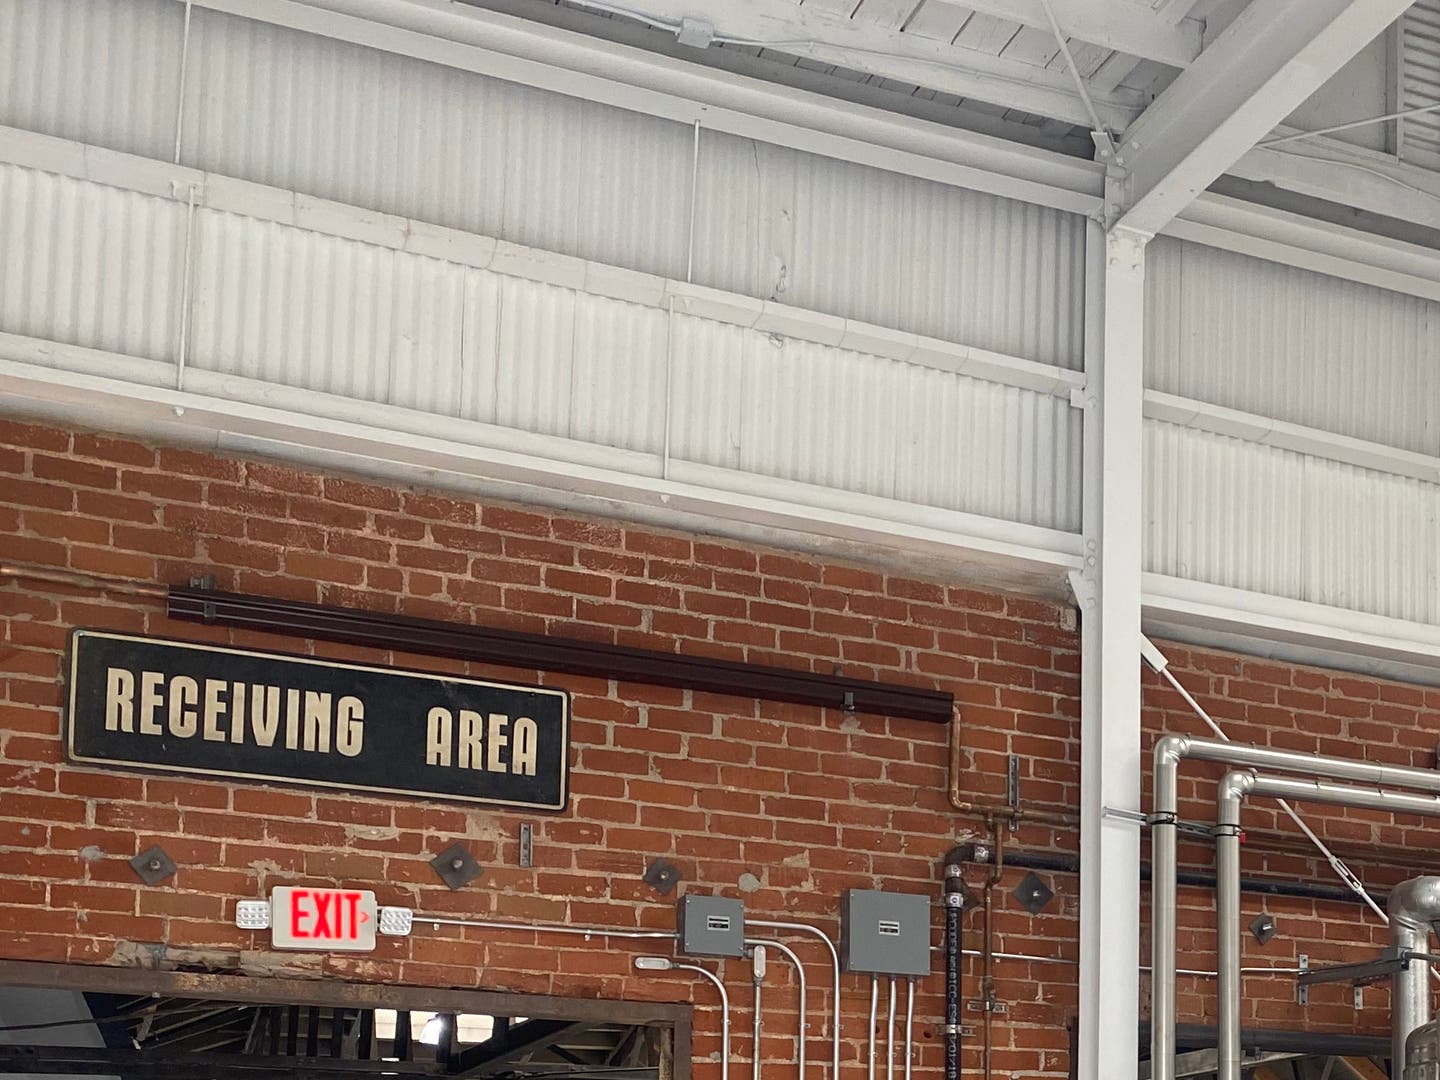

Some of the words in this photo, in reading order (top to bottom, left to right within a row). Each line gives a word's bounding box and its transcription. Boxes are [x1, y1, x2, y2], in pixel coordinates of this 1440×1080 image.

[105, 665, 364, 757] RECEIVING
[426, 706, 539, 776] AREA
[291, 889, 360, 941] EXIT
